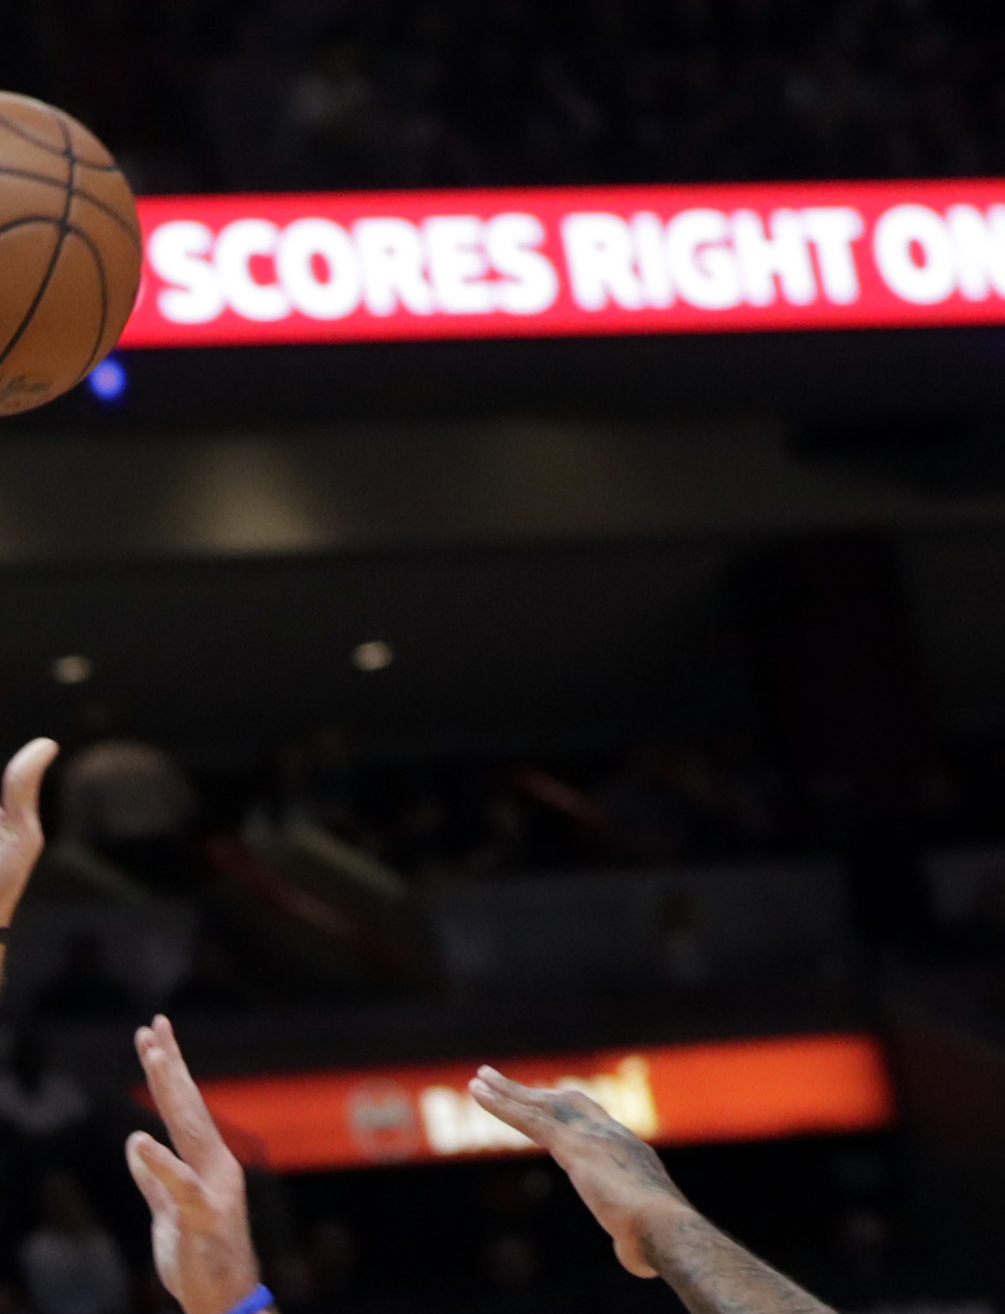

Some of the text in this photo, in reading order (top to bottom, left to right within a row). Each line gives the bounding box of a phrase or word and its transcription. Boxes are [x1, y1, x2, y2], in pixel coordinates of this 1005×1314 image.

[147, 211, 559, 324] SCORES
[560, 207, 865, 312] RIGHT
[872, 202, 1005, 305] ON
